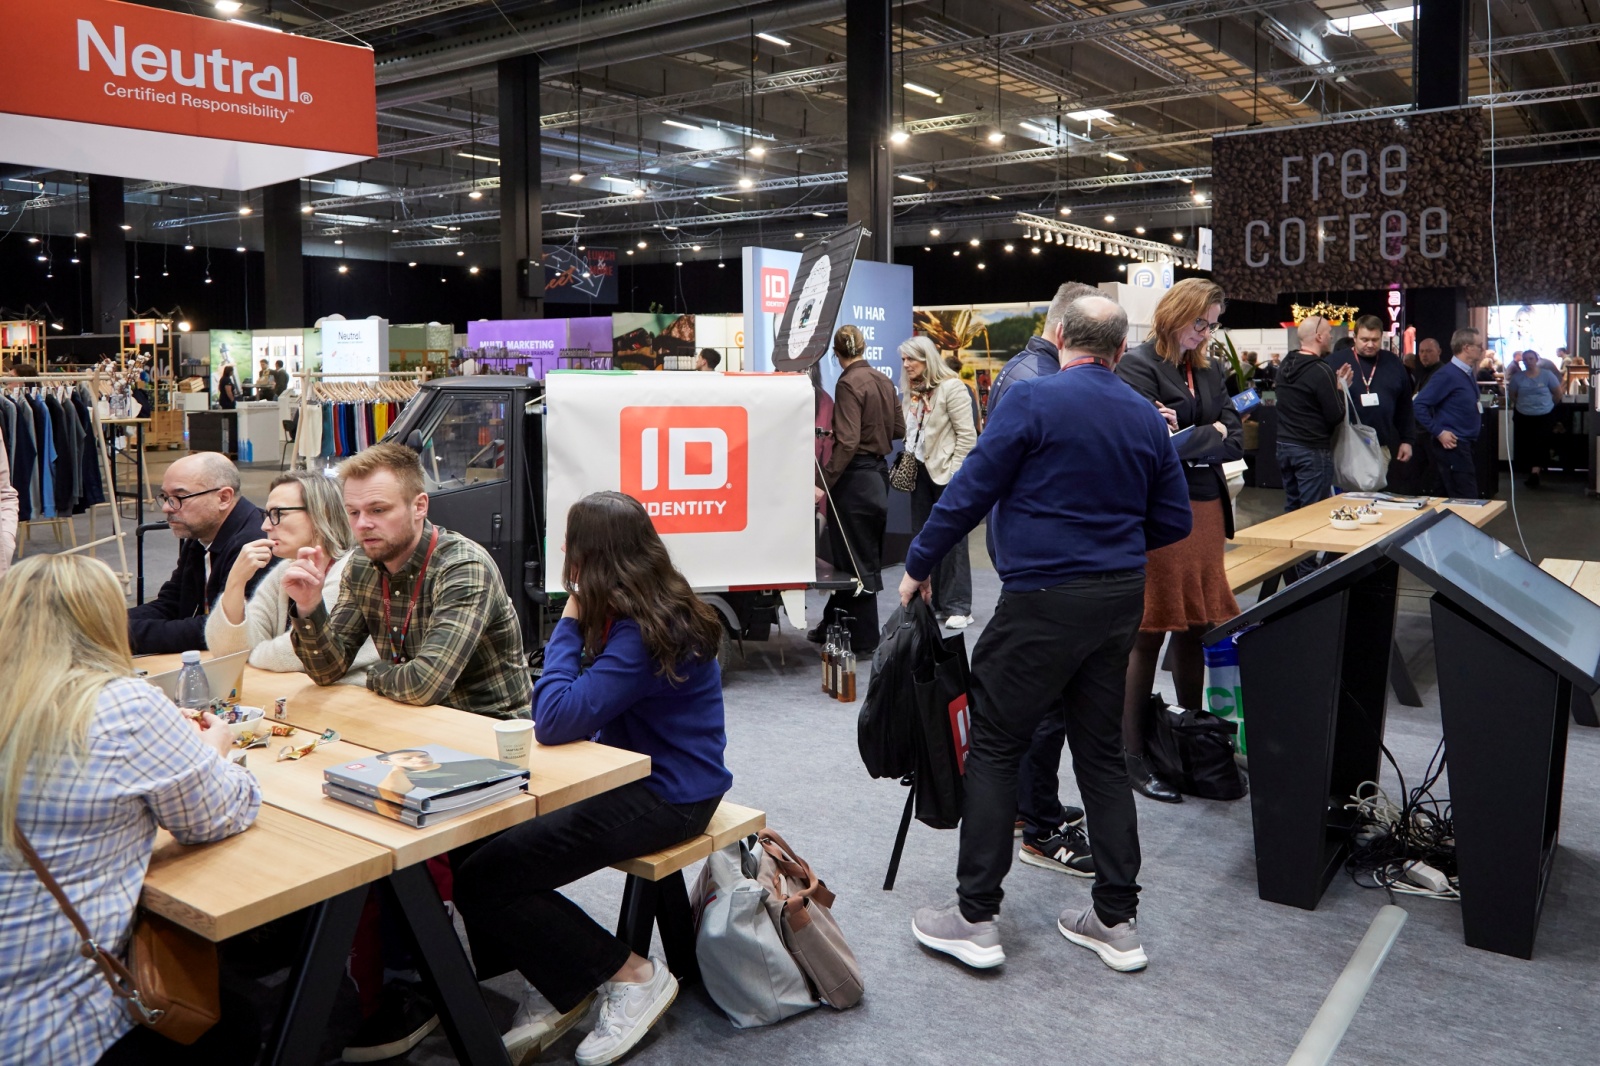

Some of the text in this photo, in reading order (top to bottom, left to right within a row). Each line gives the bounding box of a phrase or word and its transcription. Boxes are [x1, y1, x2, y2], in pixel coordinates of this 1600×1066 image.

[103, 82, 176, 105] Certified
[1281, 144, 1408, 204] Free
[853, 304, 886, 321] VI HAR
[506, 339, 555, 350] MARKETING
[1053, 846, 1075, 864] N
